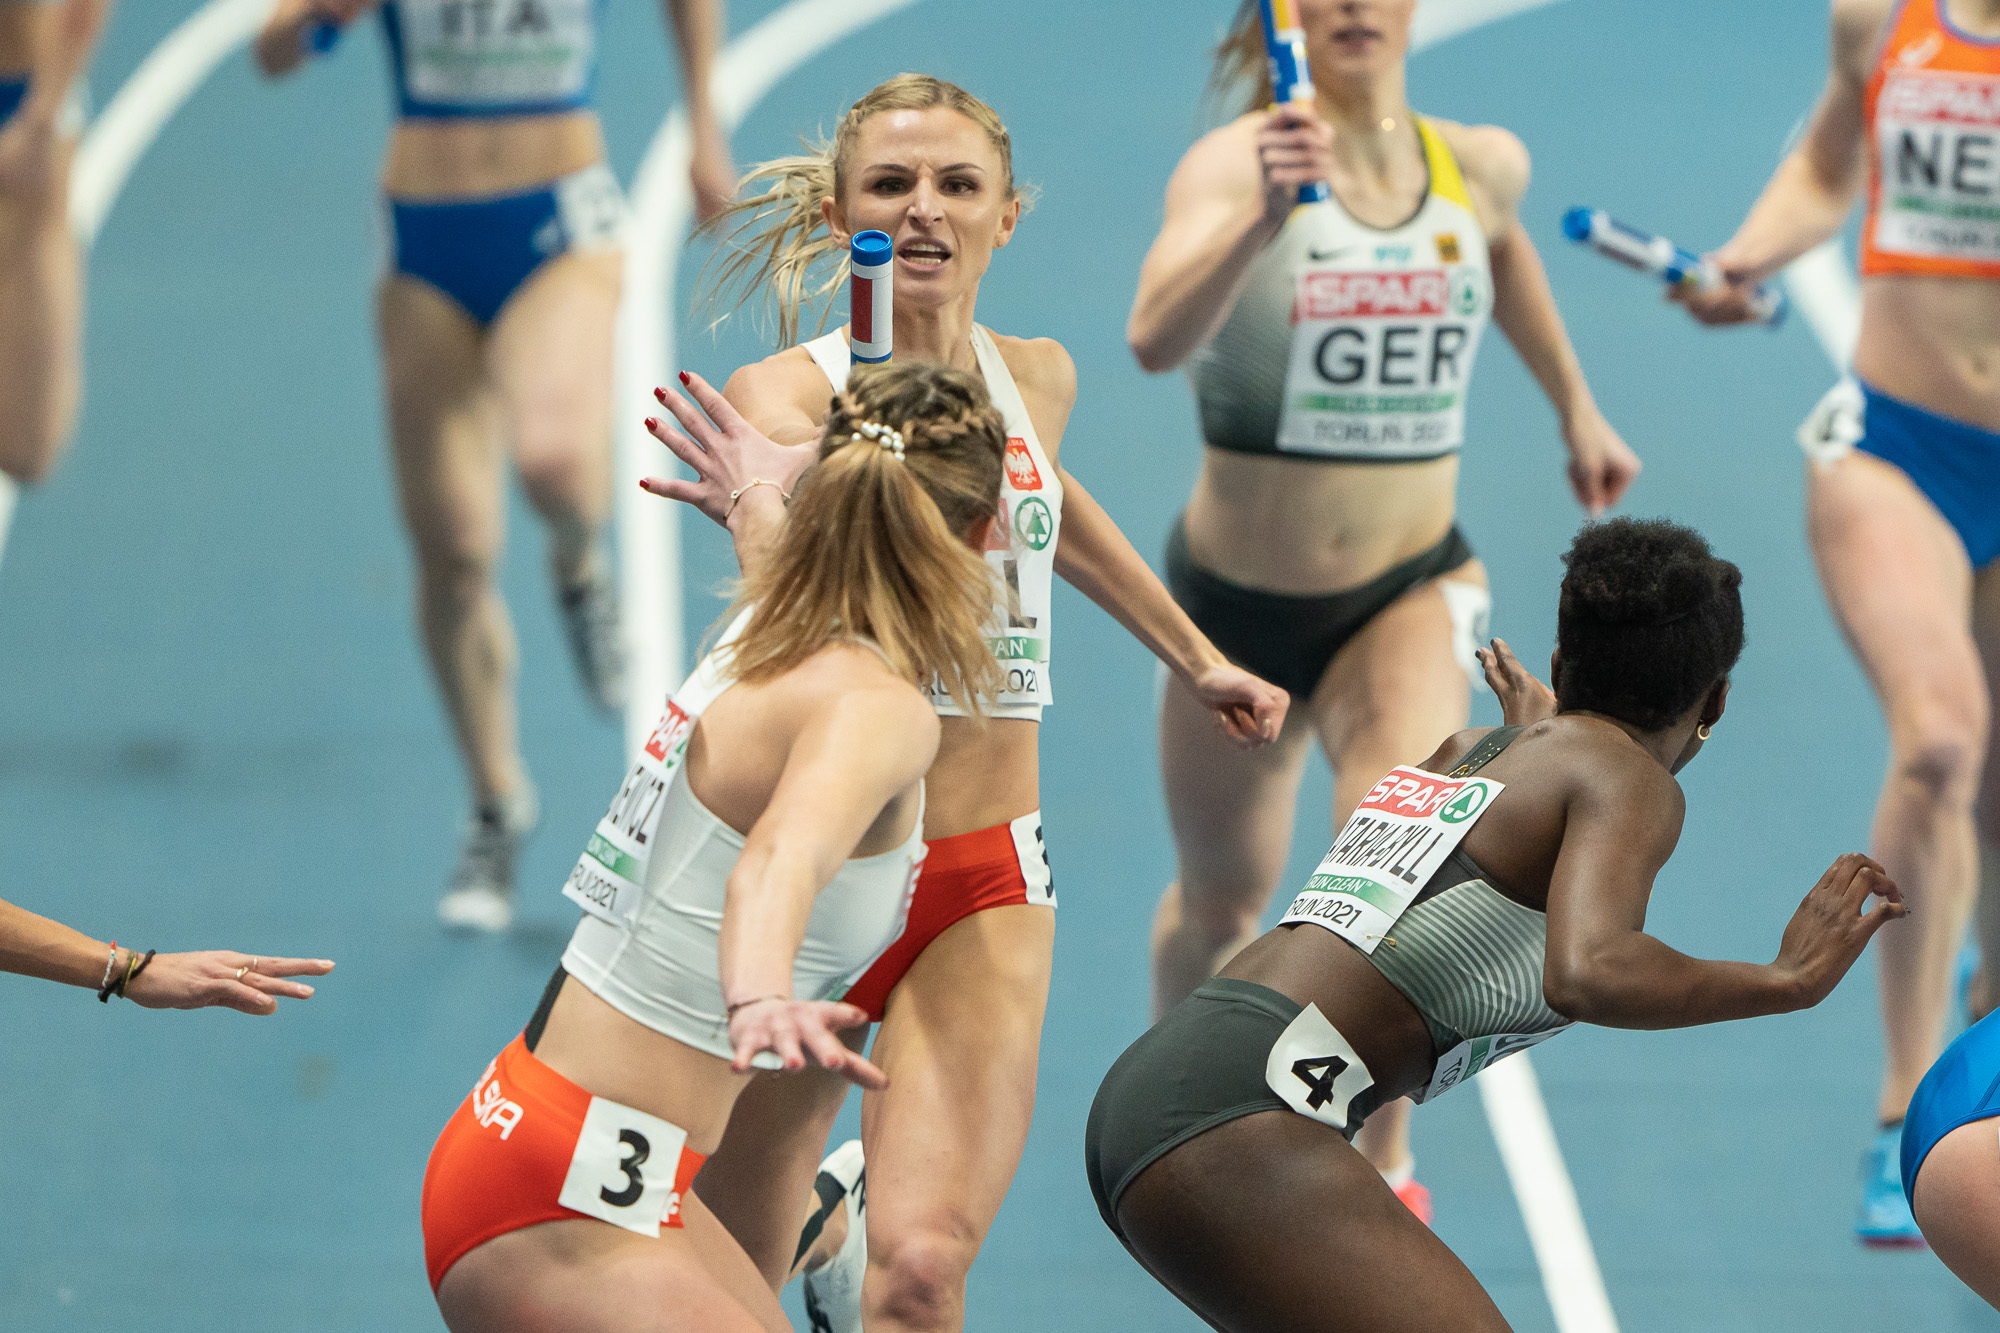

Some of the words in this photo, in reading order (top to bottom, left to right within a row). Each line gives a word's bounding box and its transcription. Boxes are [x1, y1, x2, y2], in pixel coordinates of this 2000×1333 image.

[1897, 130, 1992, 196] NE
[1310, 275, 1443, 317] SPAR
[1314, 326, 1466, 386] GER
[1363, 774, 1458, 813] SPAR
[1305, 875, 1334, 890] RUN
[1313, 899, 1363, 929] 2021
[1291, 1055, 1349, 1112] 4
[599, 1128, 651, 1208] 3
